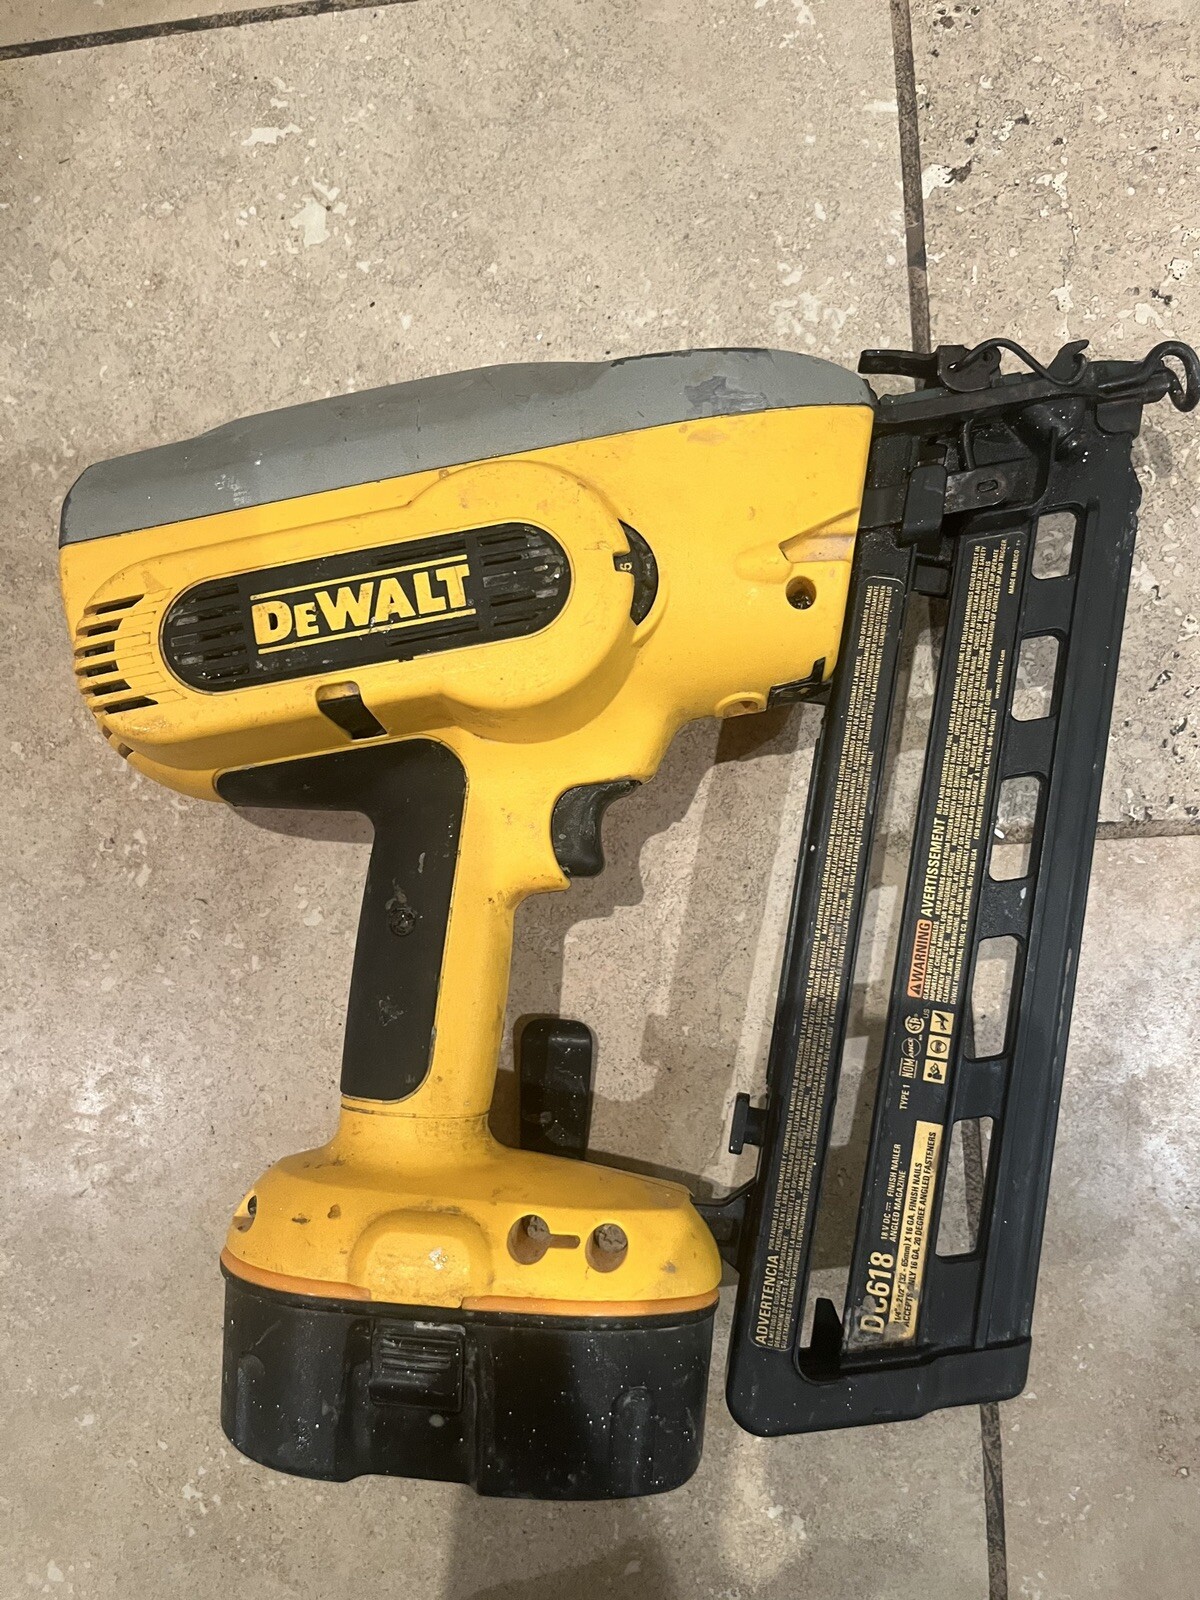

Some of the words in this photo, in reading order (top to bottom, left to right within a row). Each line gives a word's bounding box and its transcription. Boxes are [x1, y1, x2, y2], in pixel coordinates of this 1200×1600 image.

[920, 817, 946, 917] AVERTISSEMENT
[910, 922, 930, 982] WARNING
[922, 1008, 930, 1018] US
[901, 1057, 915, 1078] NOM
[899, 1089, 909, 1109] TYPE
[890, 1143, 900, 1170] NAILER
[923, 1132, 936, 1174] FASTENERS
[886, 1171, 896, 1196] FINISH
[912, 1162, 922, 1185] NAILS
[893, 1169, 906, 1210] MAGAZINE
[908, 1186, 919, 1211] FINISH
[918, 1175, 930, 1205] ANGLED
[882, 1212, 890, 1224] DC
[888, 1211, 900, 1242] ANGLED
[905, 1226, 913, 1234] 16
[906, 1212, 915, 1225] GA.
[914, 1206, 926, 1235] DEGREE
[880, 1231, 888, 1240] 18
[913, 1236, 921, 1245] 20
[911, 1246, 920, 1259] GA.
[754, 1253, 779, 1344] ADVERTENCIA
[901, 1292, 913, 1327] ACCEPTS
